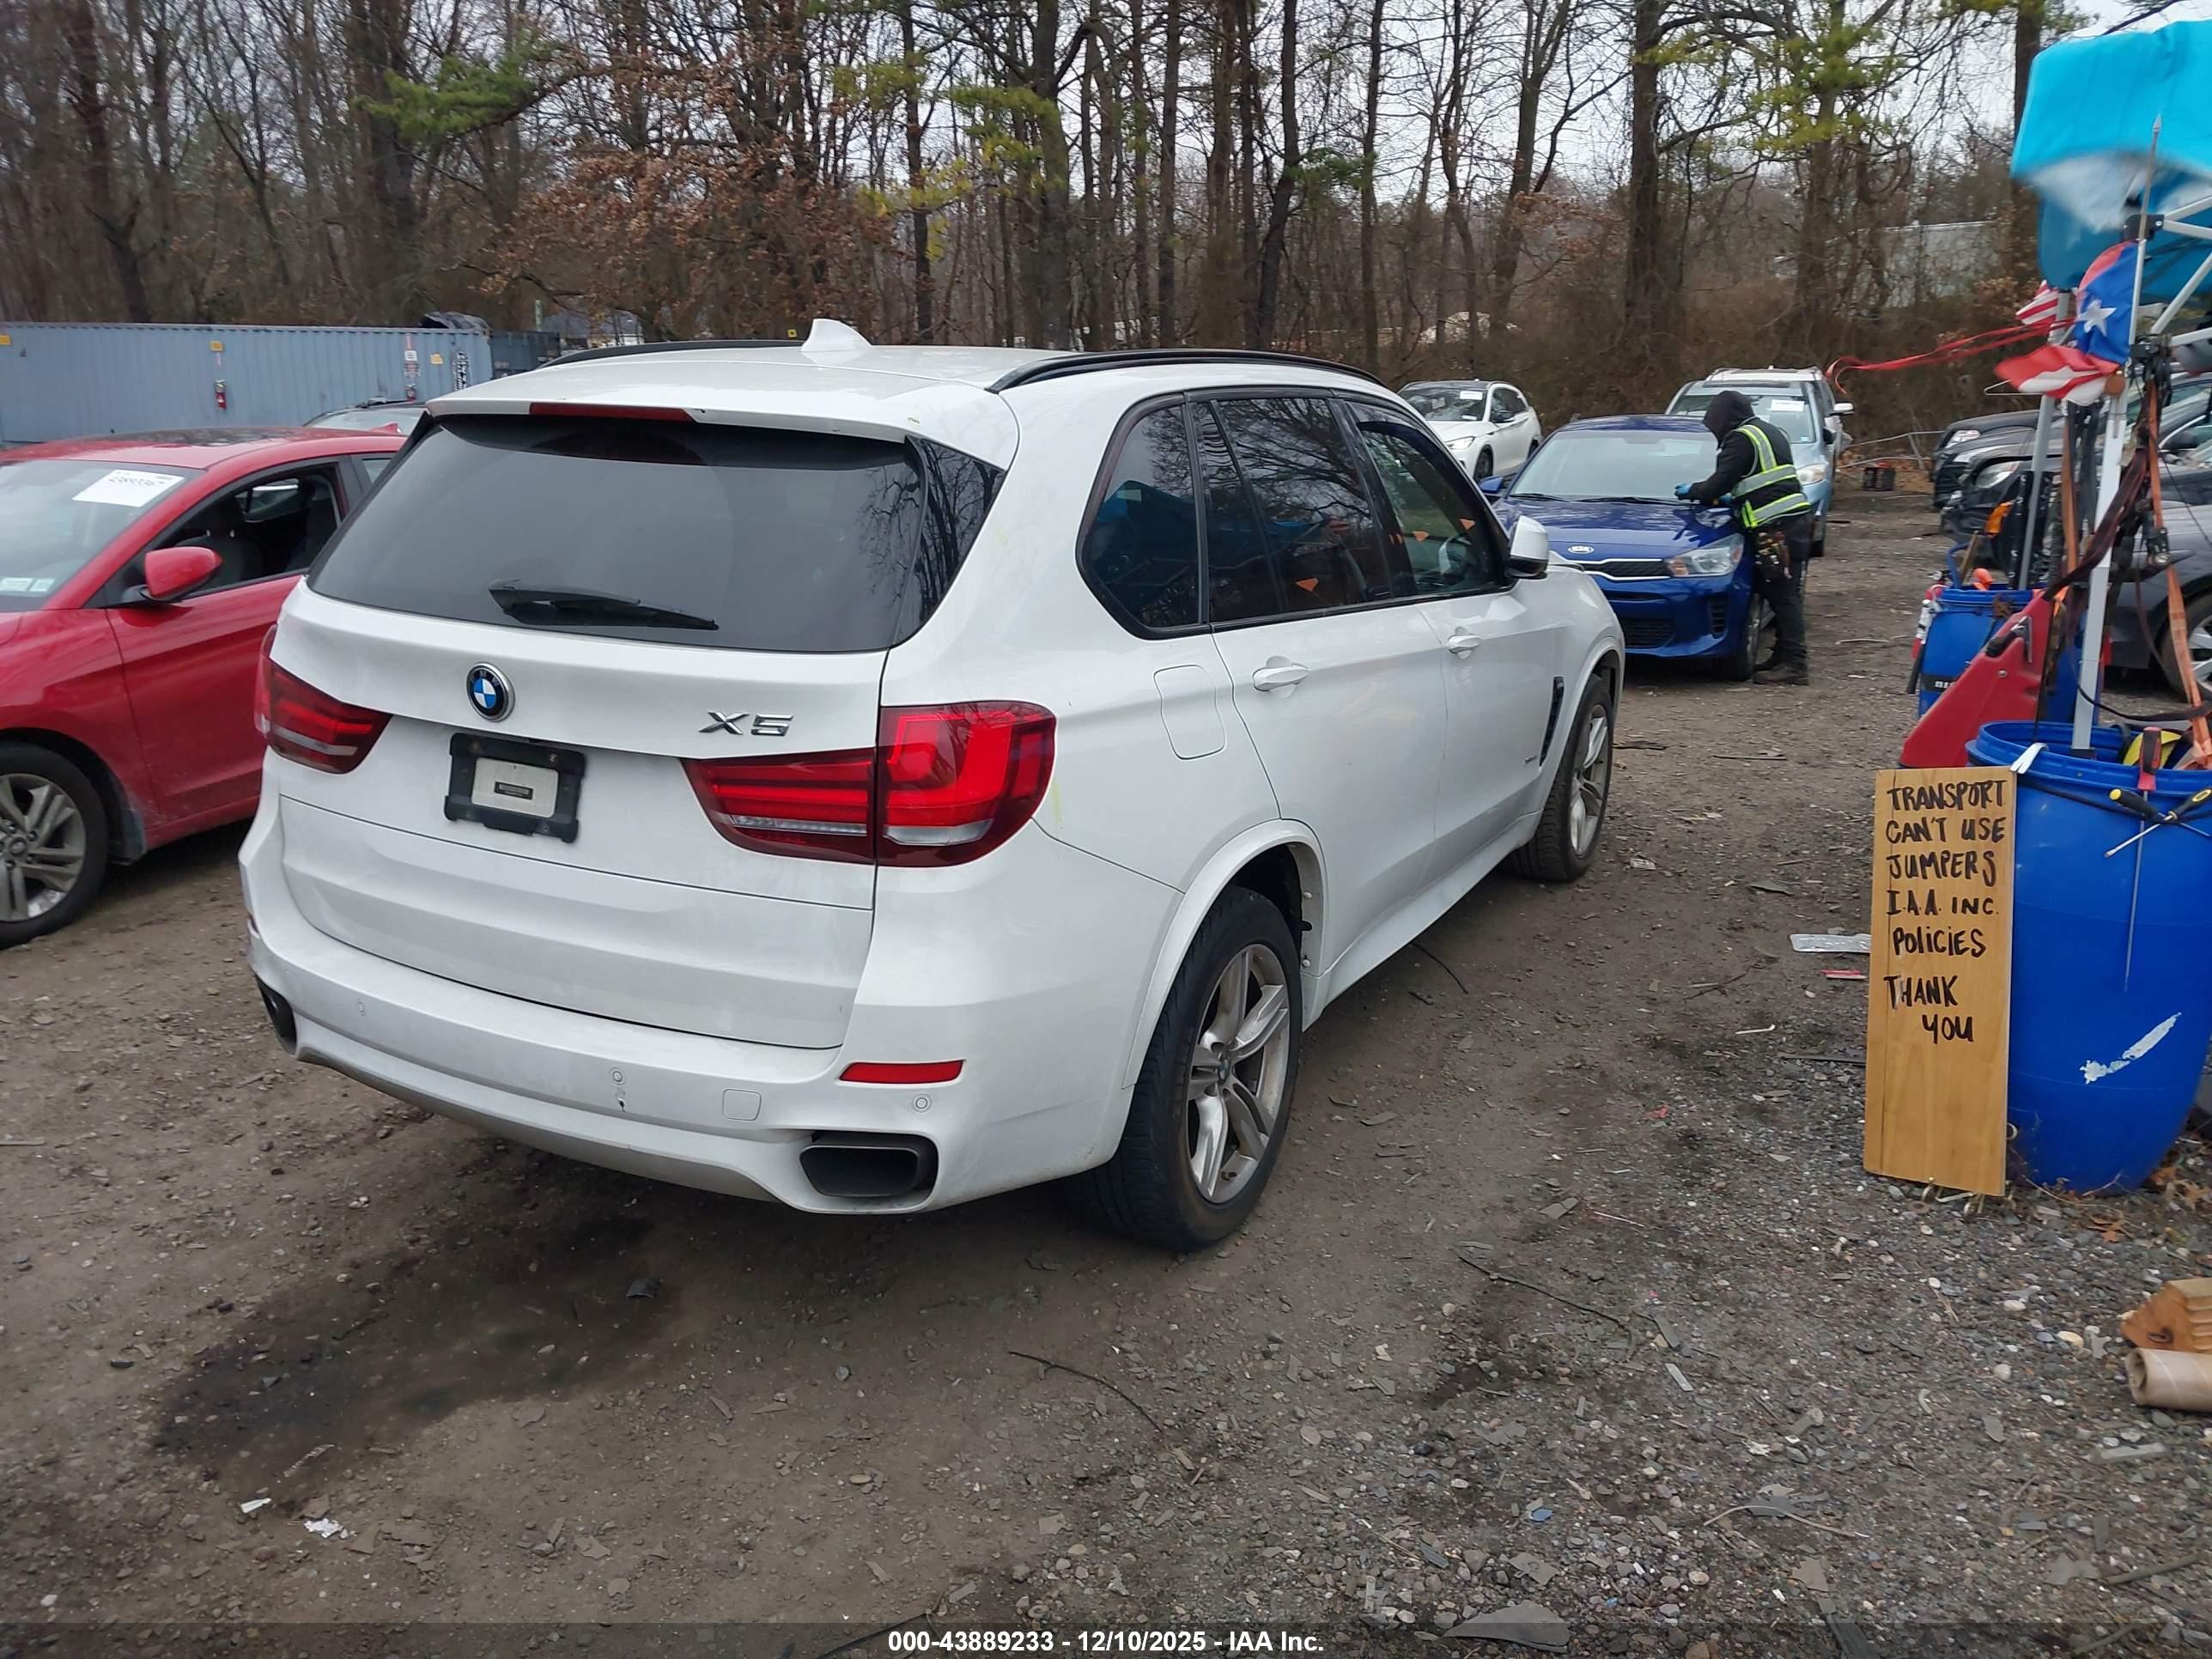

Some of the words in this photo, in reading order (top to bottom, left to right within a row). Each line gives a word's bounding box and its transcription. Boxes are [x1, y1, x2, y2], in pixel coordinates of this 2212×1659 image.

[698, 711, 794, 737] X5
[1887, 780, 2007, 811] TRANSPORT
[1886, 817, 1947, 844] CAN'T
[1961, 817, 2007, 843] USE
[1886, 850, 1996, 887] JUMPERS
[1951, 896, 1999, 915] INC.
[1883, 975, 1959, 1010] THANK
[1922, 1013, 1974, 1045] YOU
